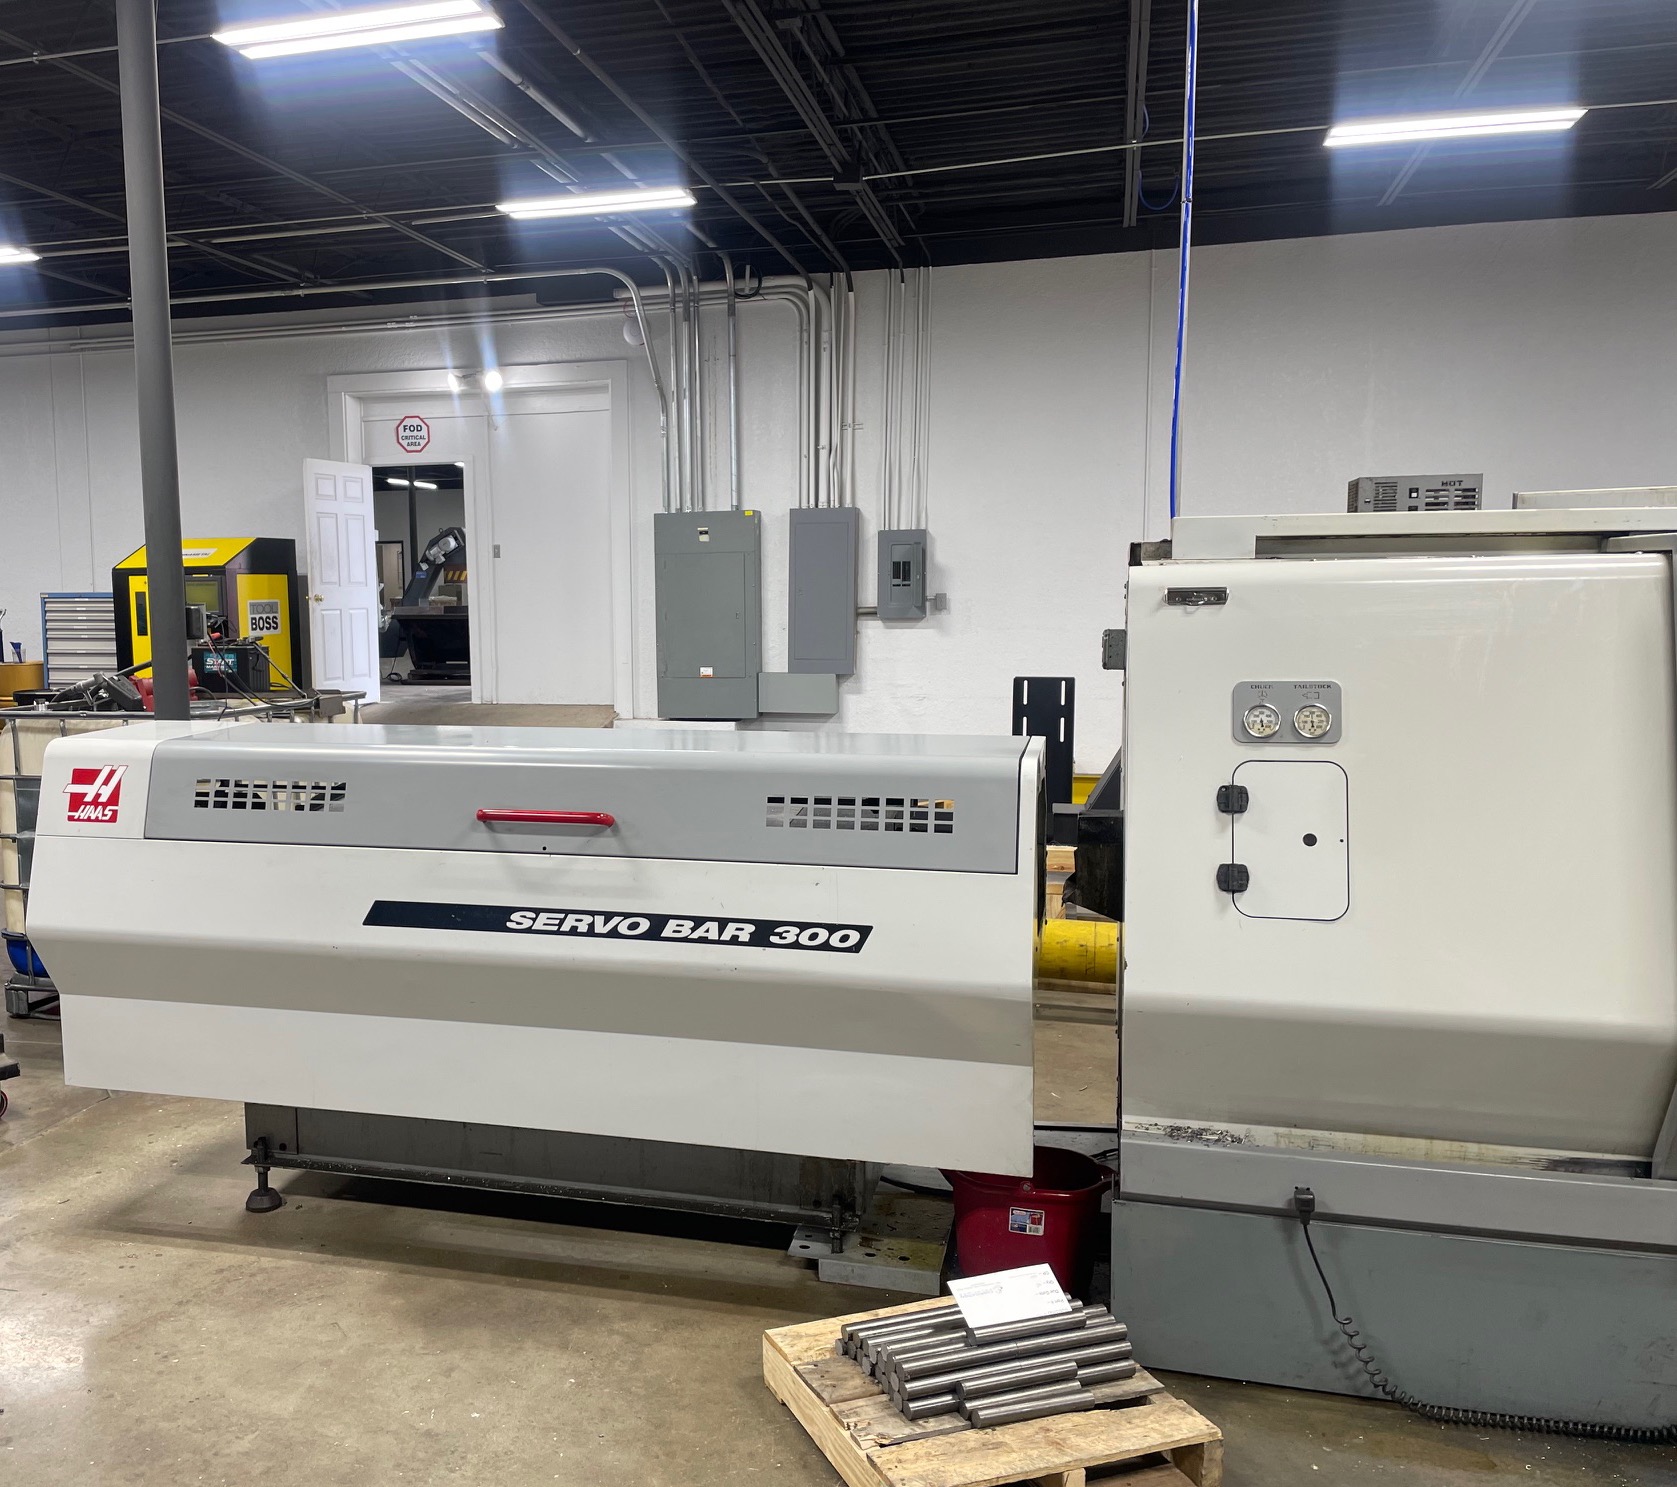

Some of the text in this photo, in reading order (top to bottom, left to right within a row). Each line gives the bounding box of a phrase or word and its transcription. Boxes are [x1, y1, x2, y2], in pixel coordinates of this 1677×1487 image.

[403, 424, 423, 433] FOD
[250, 603, 278, 615] TOOL
[250, 615, 279, 631] BOSS
[67, 804, 119, 821] HAAS
[506, 910, 861, 949] SERVO BAR 300
